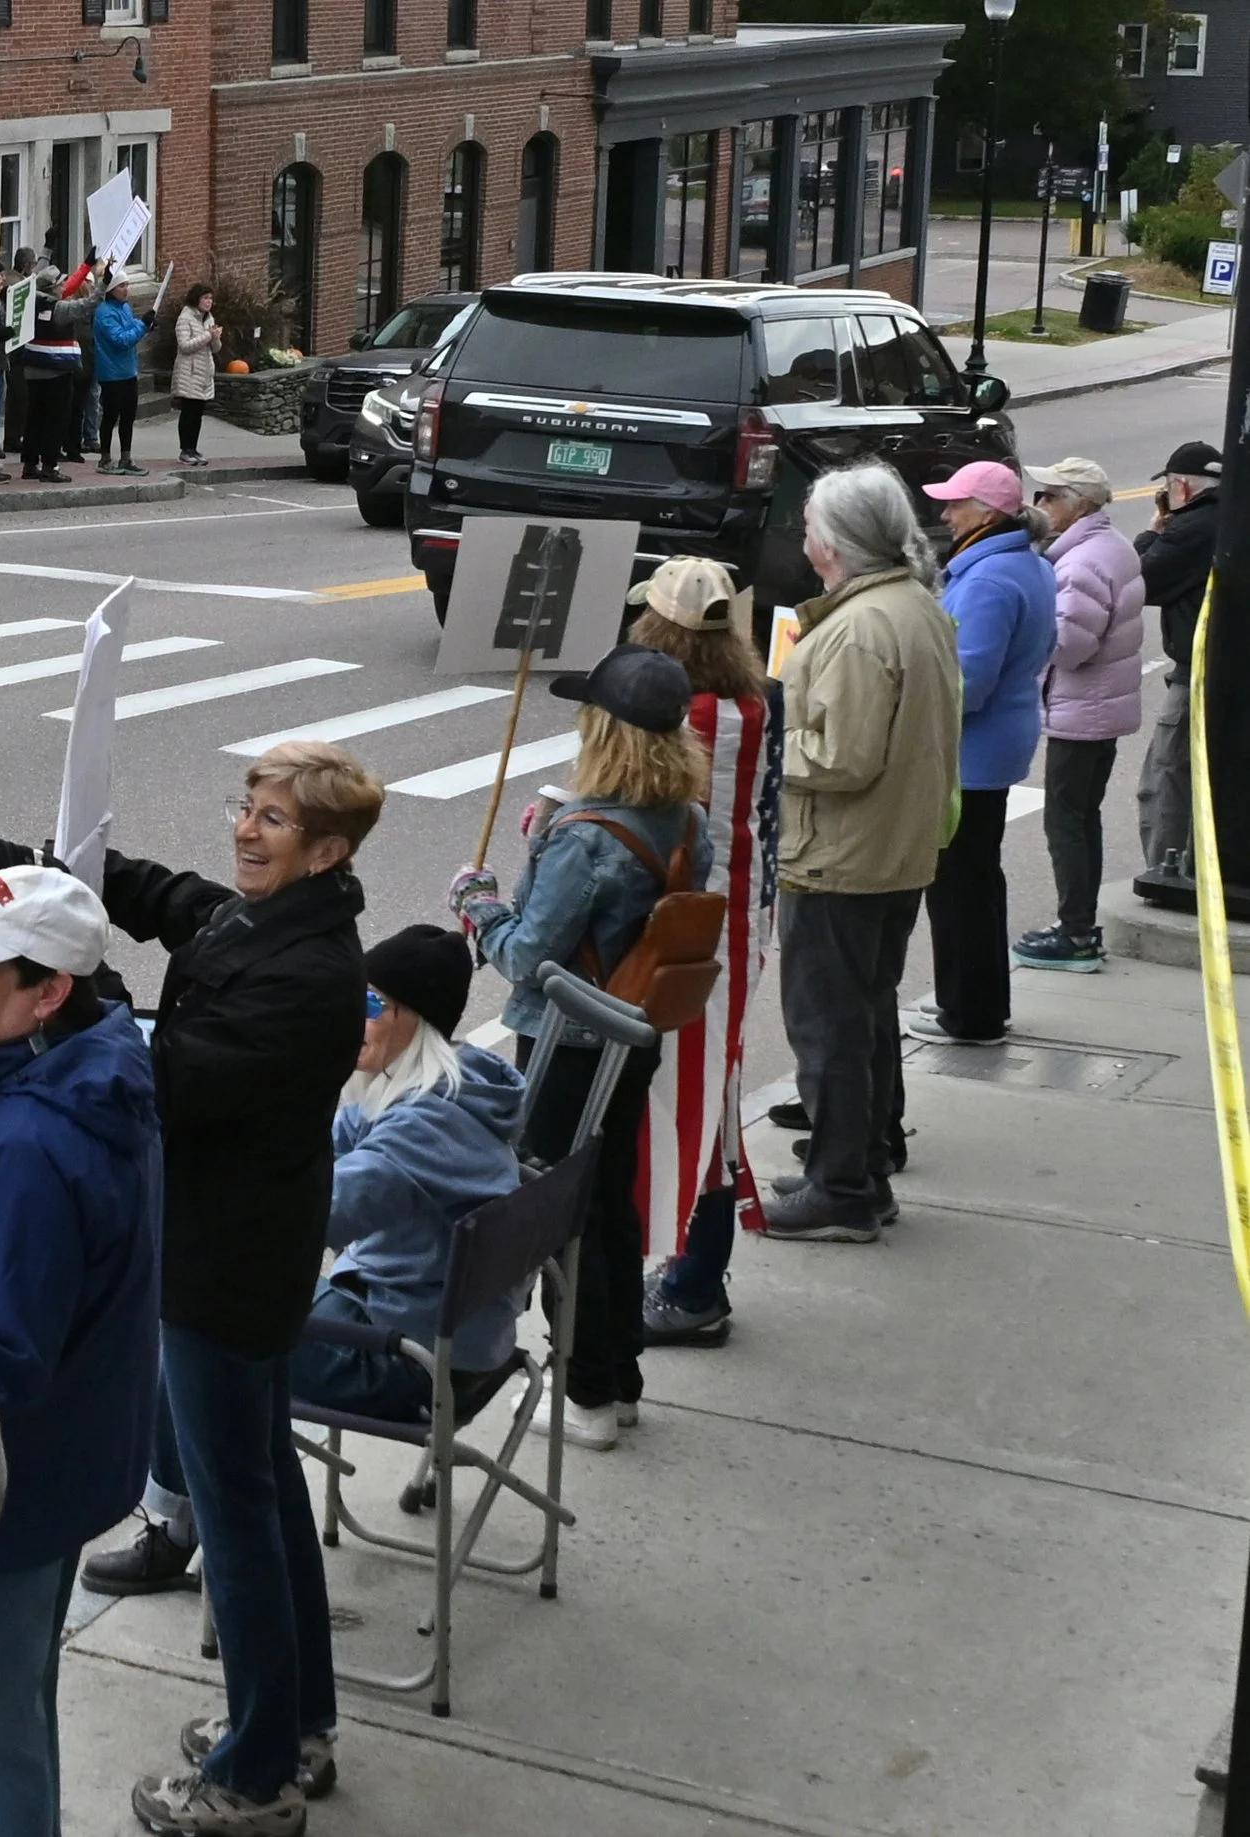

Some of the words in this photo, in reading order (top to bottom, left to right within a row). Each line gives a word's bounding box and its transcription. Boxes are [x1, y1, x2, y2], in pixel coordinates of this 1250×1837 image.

[522, 415, 639, 433] SUBURBAN
[553, 446, 576, 463] GTP
[583, 449, 606, 466] 990
